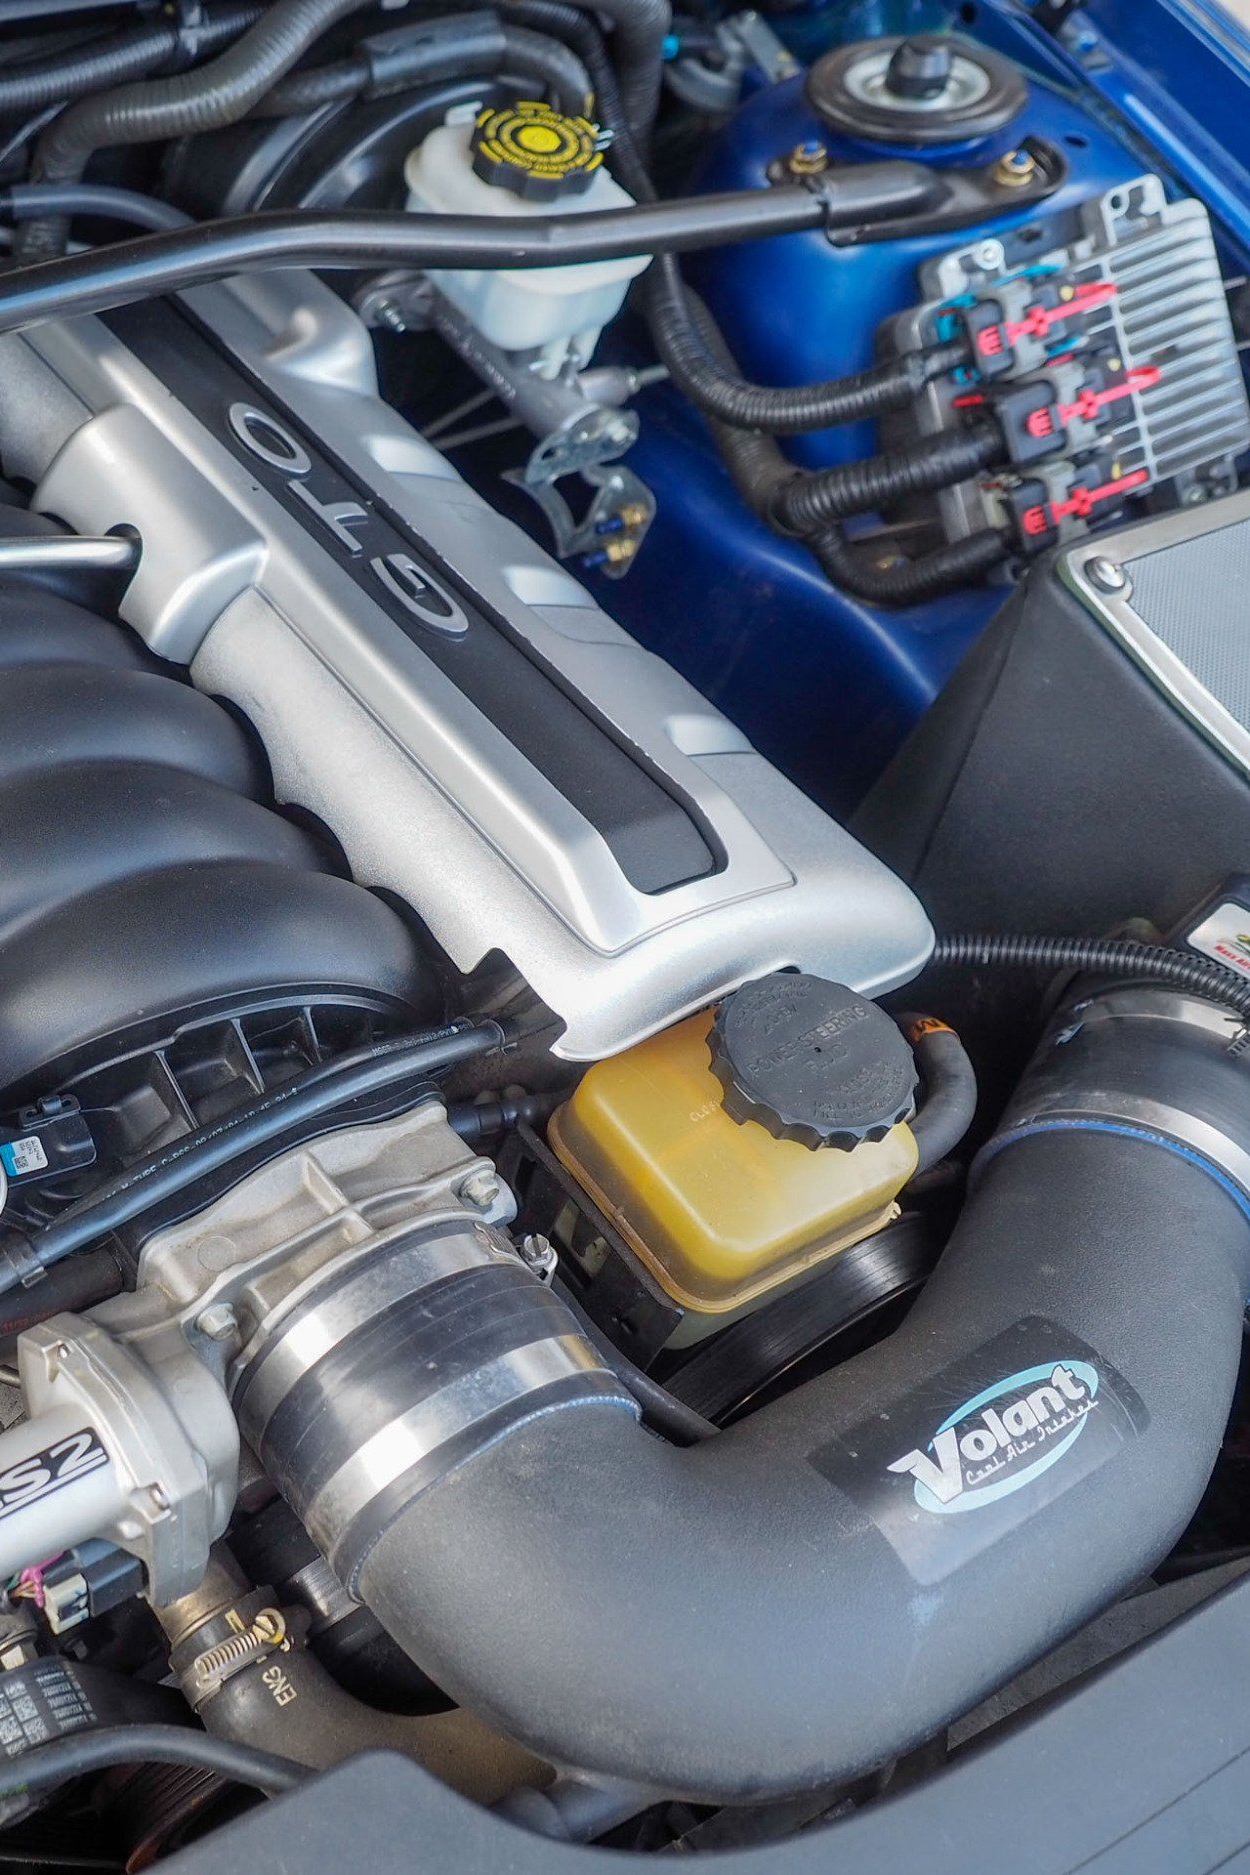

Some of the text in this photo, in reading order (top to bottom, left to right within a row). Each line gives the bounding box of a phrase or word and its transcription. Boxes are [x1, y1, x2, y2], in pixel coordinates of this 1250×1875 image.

[229, 402, 470, 640] GTO
[797, 1004, 868, 1045] STEERING
[886, 1364, 1086, 1504] Volant
[965, 1456, 1007, 1485] Cool
[1007, 1442, 1037, 1462] Air
[262, 1665, 298, 1706] ENG
